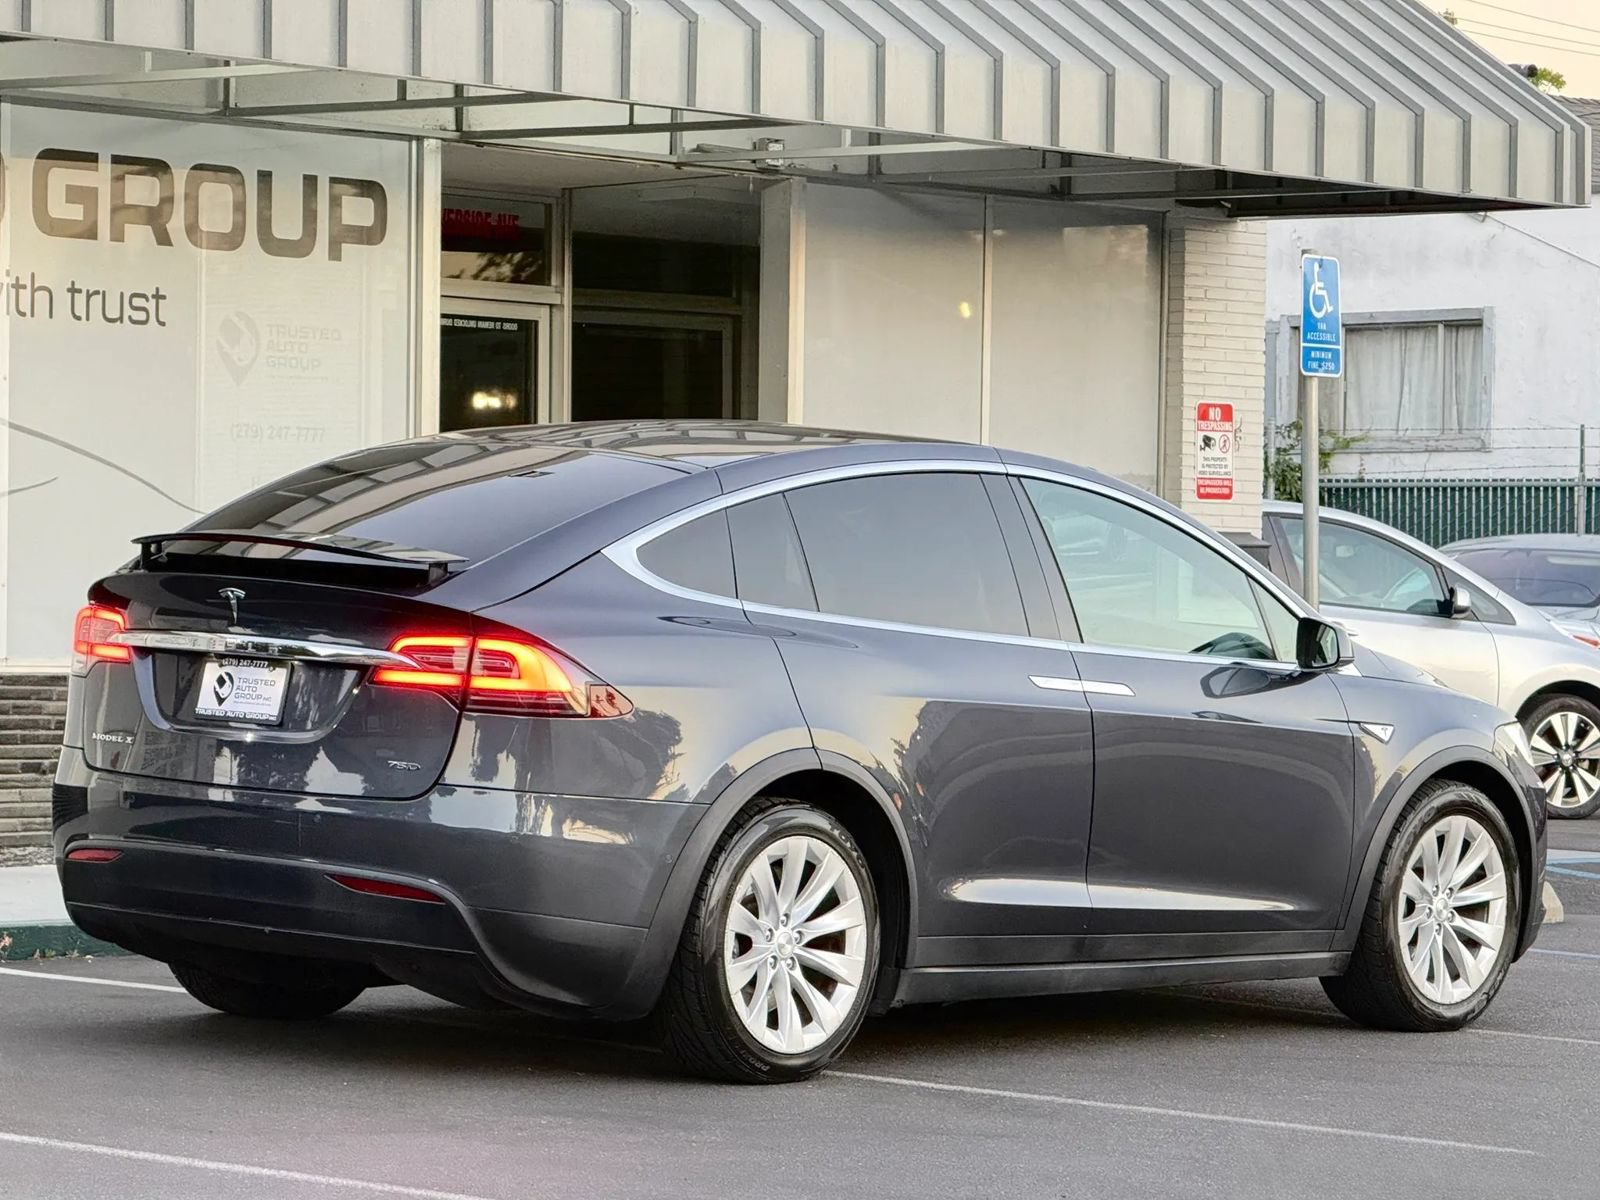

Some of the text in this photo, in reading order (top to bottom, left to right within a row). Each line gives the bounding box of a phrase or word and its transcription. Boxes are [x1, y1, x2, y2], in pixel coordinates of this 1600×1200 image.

[32, 147, 388, 262] GROUP
[0, 270, 167, 327] ith trust
[265, 323, 342, 342] TRUSTED
[1307, 332, 1336, 342] ACCESSIBLE
[265, 340, 309, 354] AUTO
[1311, 350, 1332, 359] MINIMUM
[265, 355, 321, 372] GROUP
[1208, 406, 1221, 421] NO
[230, 423, 264, 442] (279)
[222, 658, 269, 669] (279) 247-7777
[237, 677, 276, 687] TRUSTED
[235, 685, 258, 693] AUTO
[234, 692, 263, 701] GROUP
[195, 708, 225, 716] TRUSTED
[245, 712, 269, 720] GROUP
[92, 732, 135, 744] MODEL X
[387, 760, 421, 770] 75D
